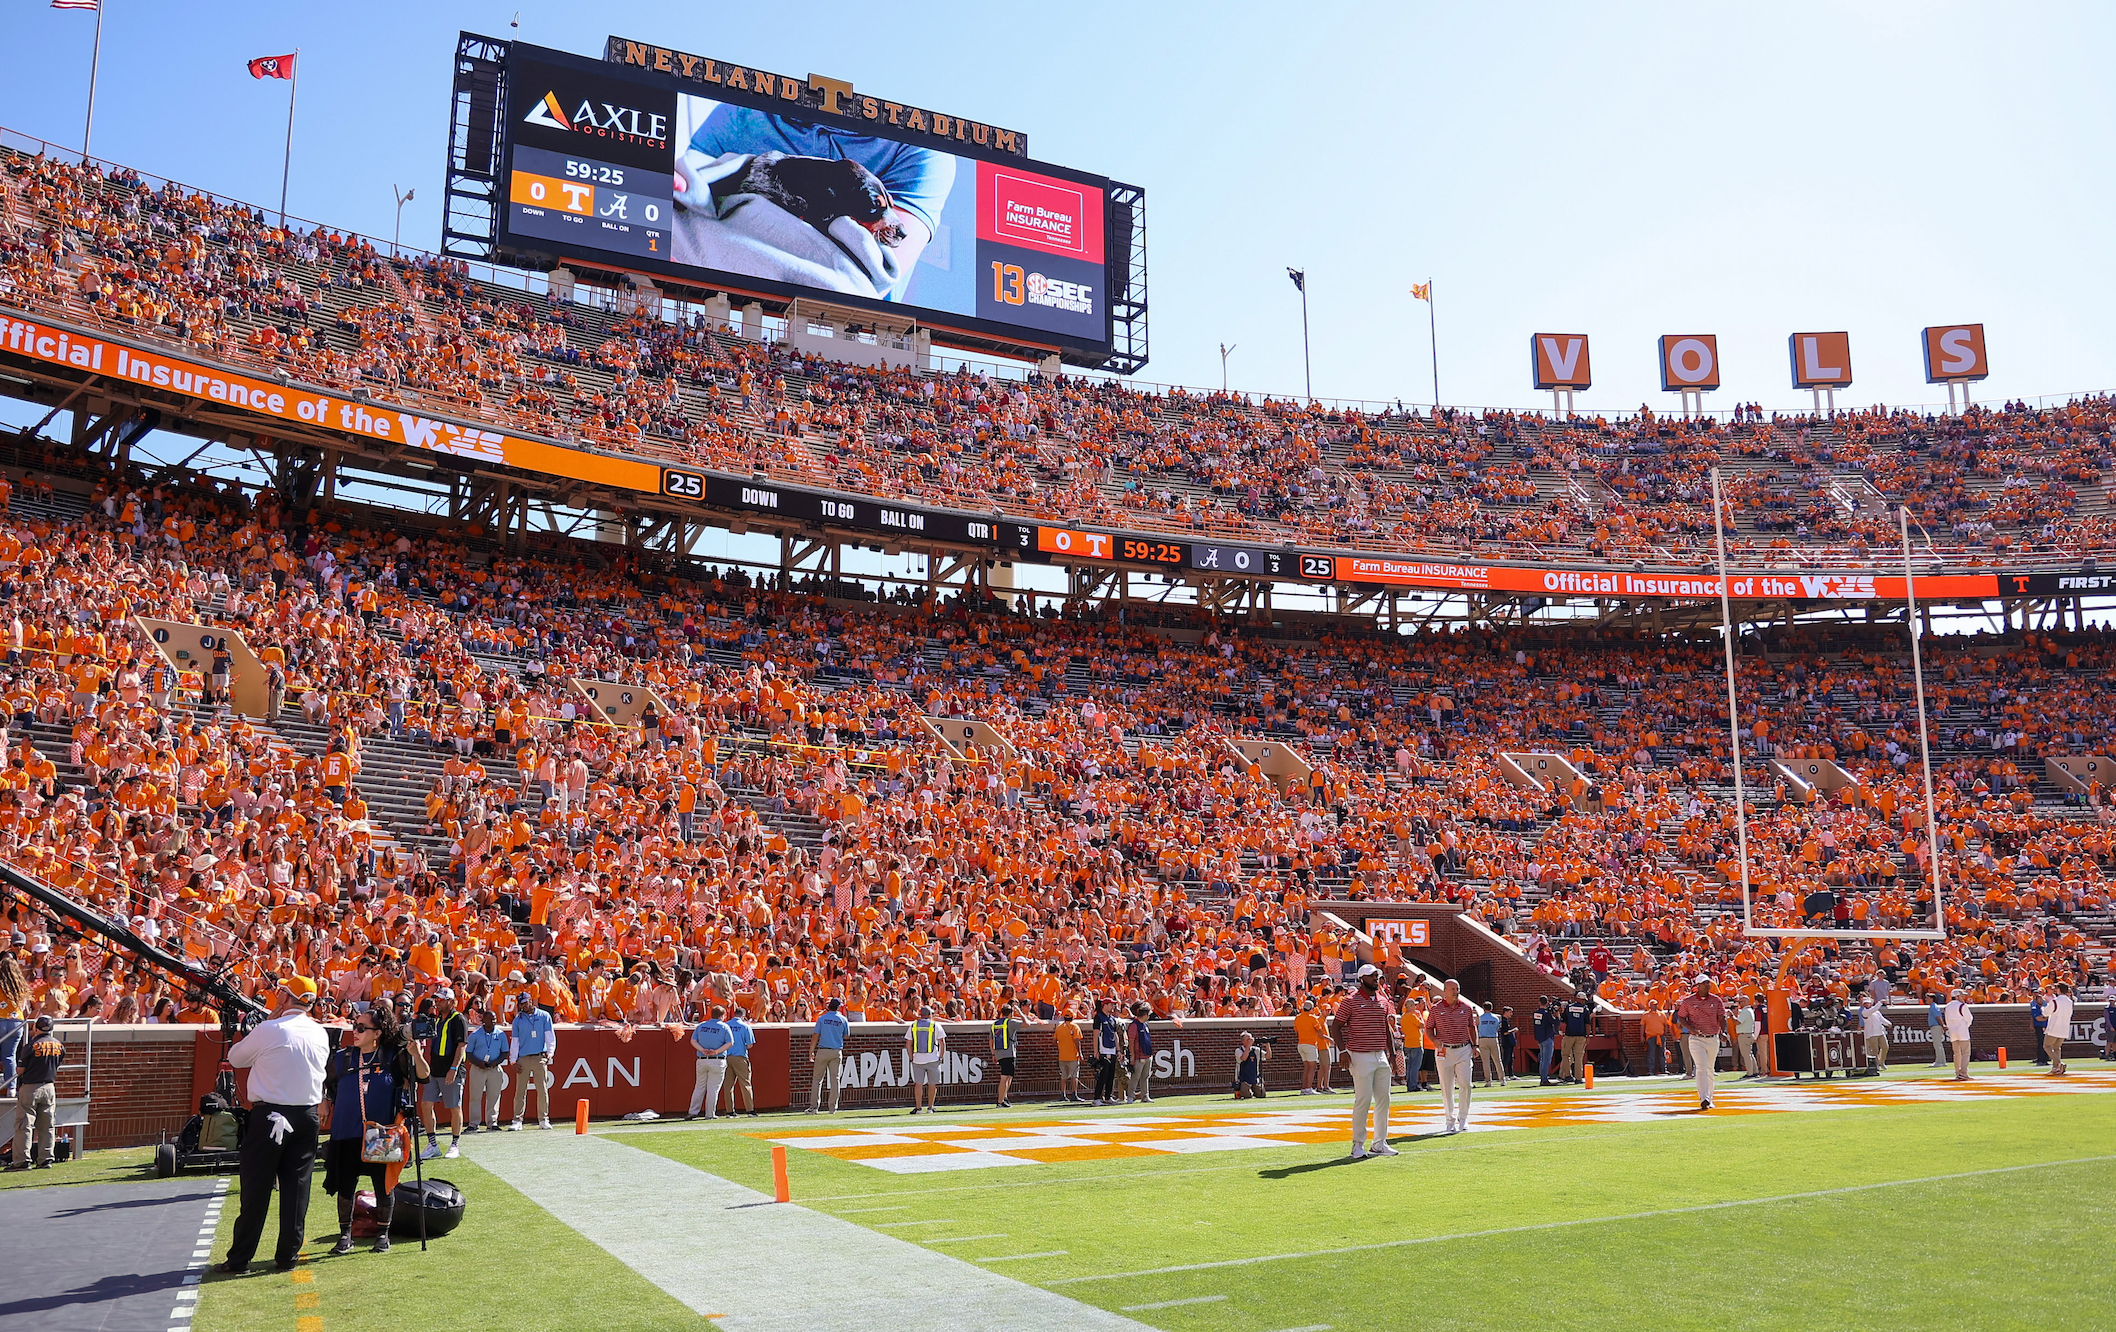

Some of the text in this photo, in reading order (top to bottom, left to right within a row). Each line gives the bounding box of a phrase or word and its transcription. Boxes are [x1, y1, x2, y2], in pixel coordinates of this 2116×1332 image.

[626, 41, 799, 101] NEYLAND
[862, 97, 1017, 152] STADIUM
[573, 99, 667, 141] AXLE
[573, 123, 666, 150] LOGISTICS
[565, 160, 624, 186] 59:25
[530, 182, 590, 212] 0 T
[644, 204, 659, 222] 0
[1006, 200, 1072, 223] Farm Bureau
[523, 207, 660, 238] DOWN TO GO BALL ON QTR
[1006, 211, 1072, 235] INSURANCE
[648, 239, 658, 251] 1
[1046, 234, 1072, 244] Tennessee
[991, 260, 1025, 306] 13
[1047, 278, 1093, 303] SEC
[1028, 291, 1093, 315] CHAMPIONSHIPS
[117, 349, 284, 414] Insurance
[297, 397, 329, 422] of
[340, 404, 390, 436] the
[669, 474, 701, 495] 25
[741, 487, 778, 509] DOWN
[821, 500, 854, 520] TO GO
[880, 509, 925, 531] BALL ON
[967, 521, 998, 541] QTR 1
[1017, 526, 1031, 534] TOL
[1019, 534, 1029, 546] 3
[1055, 532, 1071, 550] 0
[1085, 535, 1107, 557] T
[1123, 540, 1181, 564] 59:25
[1234, 551, 1250, 569] 0
[1268, 554, 1281, 562] TOL
[1271, 561, 1280, 573] 3
[1305, 558, 1330, 576] 25
[1352, 560, 1488, 578] Farm Bureau INSURANCE
[1543, 572, 1618, 593] Official
[1626, 575, 1722, 597] Insurance
[1733, 577, 1754, 596] of
[1761, 578, 1796, 596] the
[204, 637, 212, 648] J
[622, 694, 631, 703] K
[966, 728, 973, 736] L
[1263, 748, 1270, 757] M
[328, 761, 340, 776] 16
[1540, 760, 1546, 768] N
[1811, 765, 1817, 774] O
[2089, 763, 2095, 771] P
[299, 877, 307, 889] 5
[774, 978, 789, 996] 16
[1042, 978, 1049, 990] 1
[504, 994, 516, 1012] 16
[1893, 1025, 1951, 1043] fitnes
[34, 1048, 62, 1057] STAFF
[1149, 1039, 1196, 1079] sh
[897, 1048, 983, 1087] JHNS
